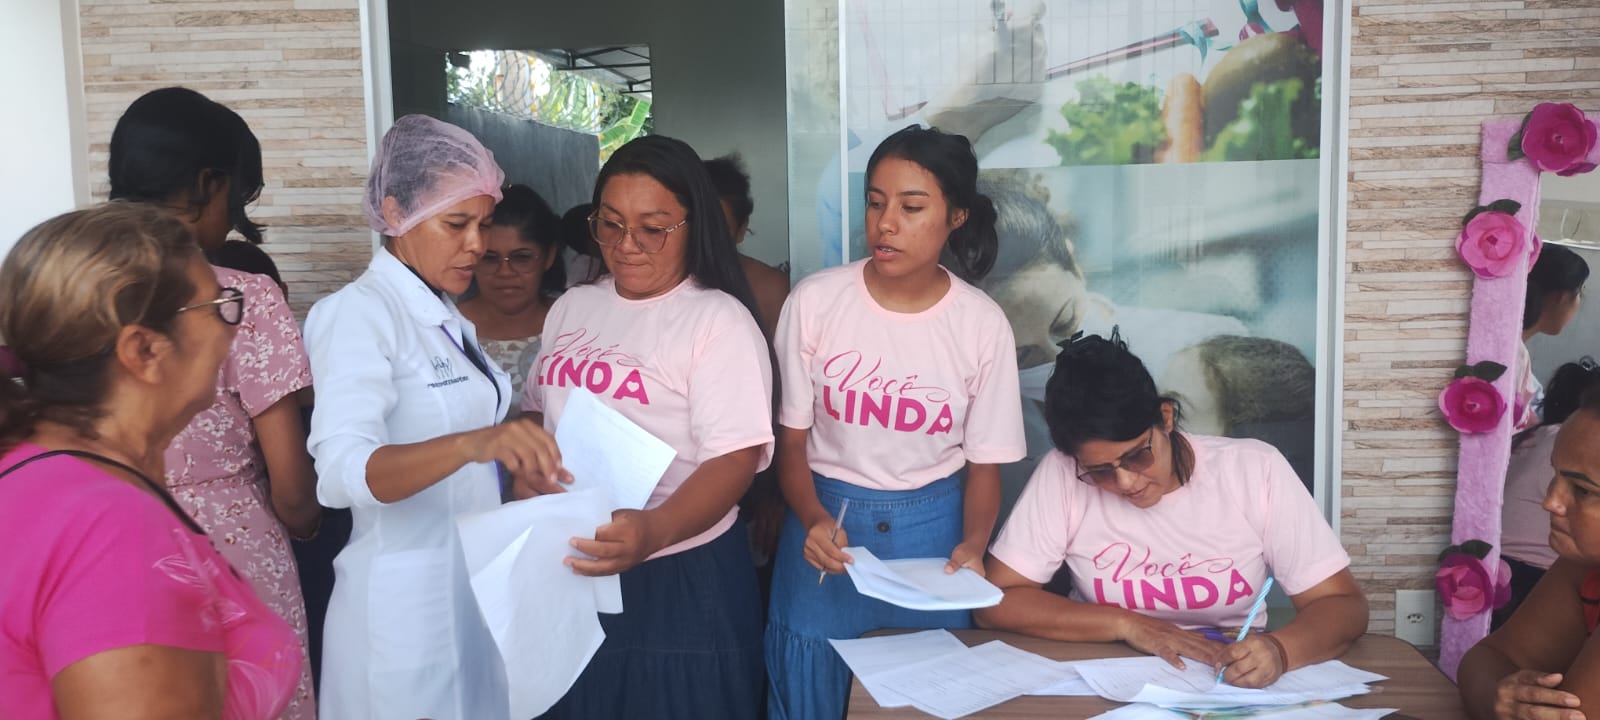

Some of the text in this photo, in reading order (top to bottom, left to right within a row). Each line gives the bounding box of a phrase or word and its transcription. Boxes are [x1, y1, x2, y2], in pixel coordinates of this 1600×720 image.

[823, 350, 950, 402] Você
[823, 385, 953, 435] LINDA
[1093, 542, 1234, 582] Você
[1093, 569, 1253, 610] LINDA
